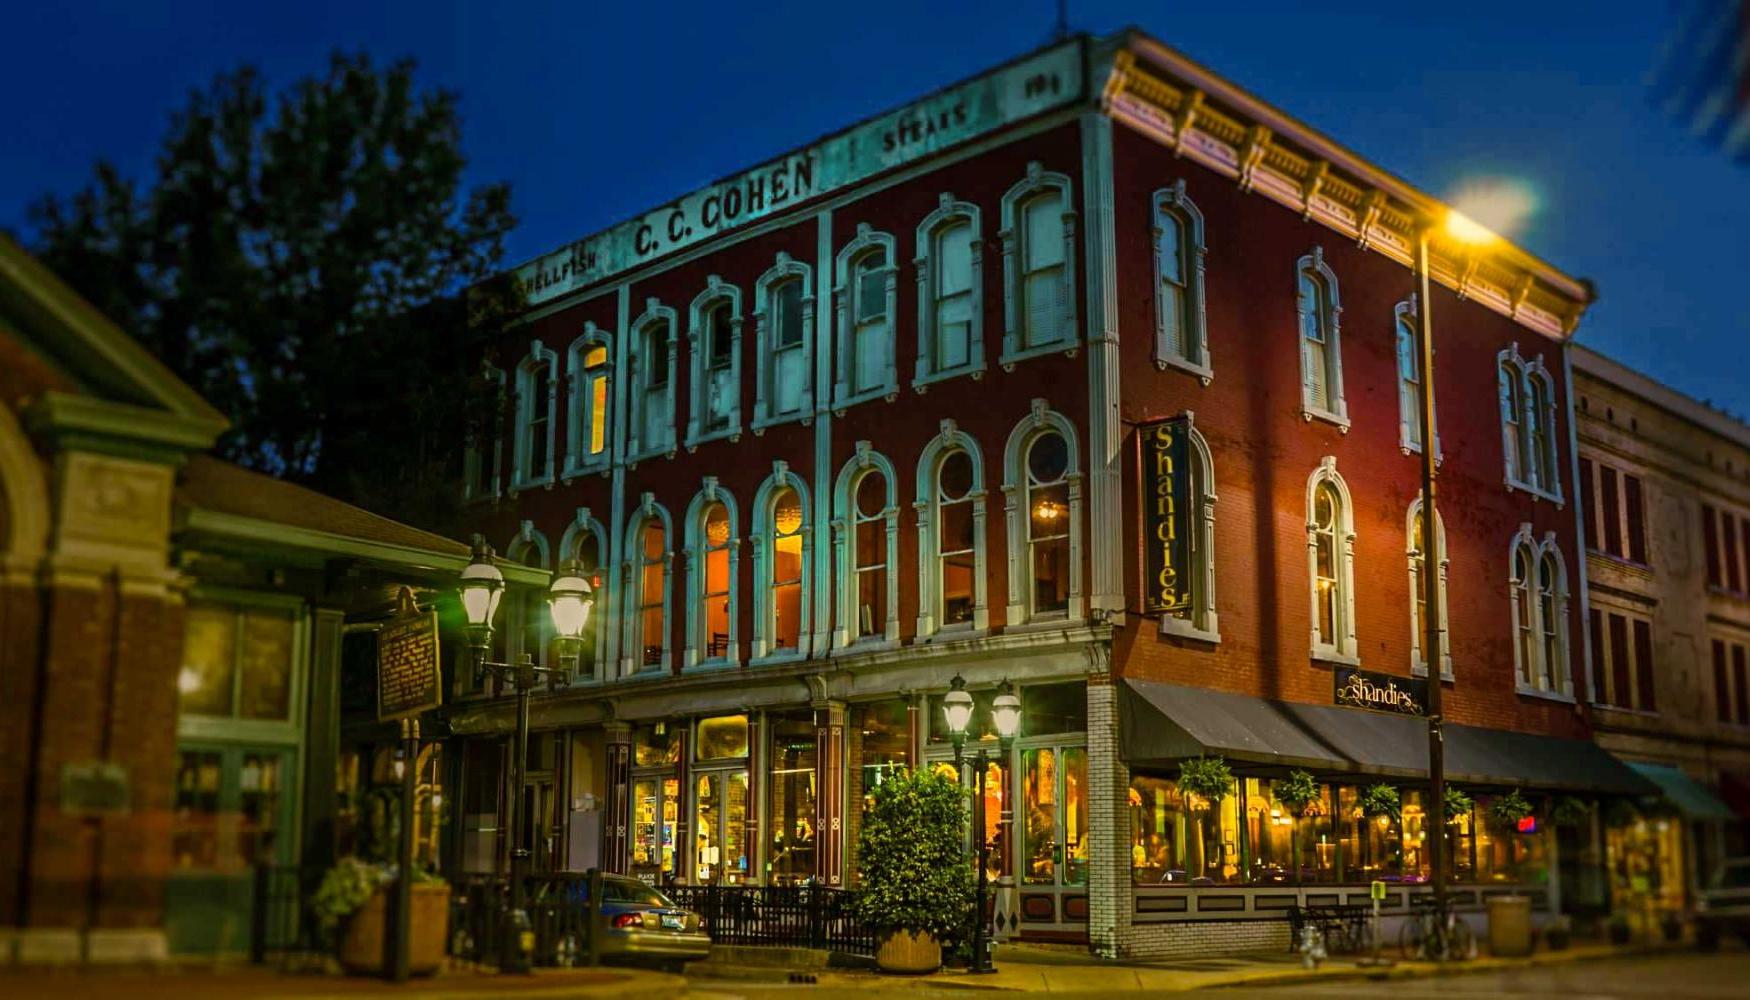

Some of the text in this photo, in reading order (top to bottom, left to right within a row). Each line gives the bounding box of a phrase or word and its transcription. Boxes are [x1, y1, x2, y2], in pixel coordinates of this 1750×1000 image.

[635, 155, 814, 256] C. C. COHEN
[525, 252, 596, 293] HELLFISH
[1155, 425, 1177, 608] Shandies
